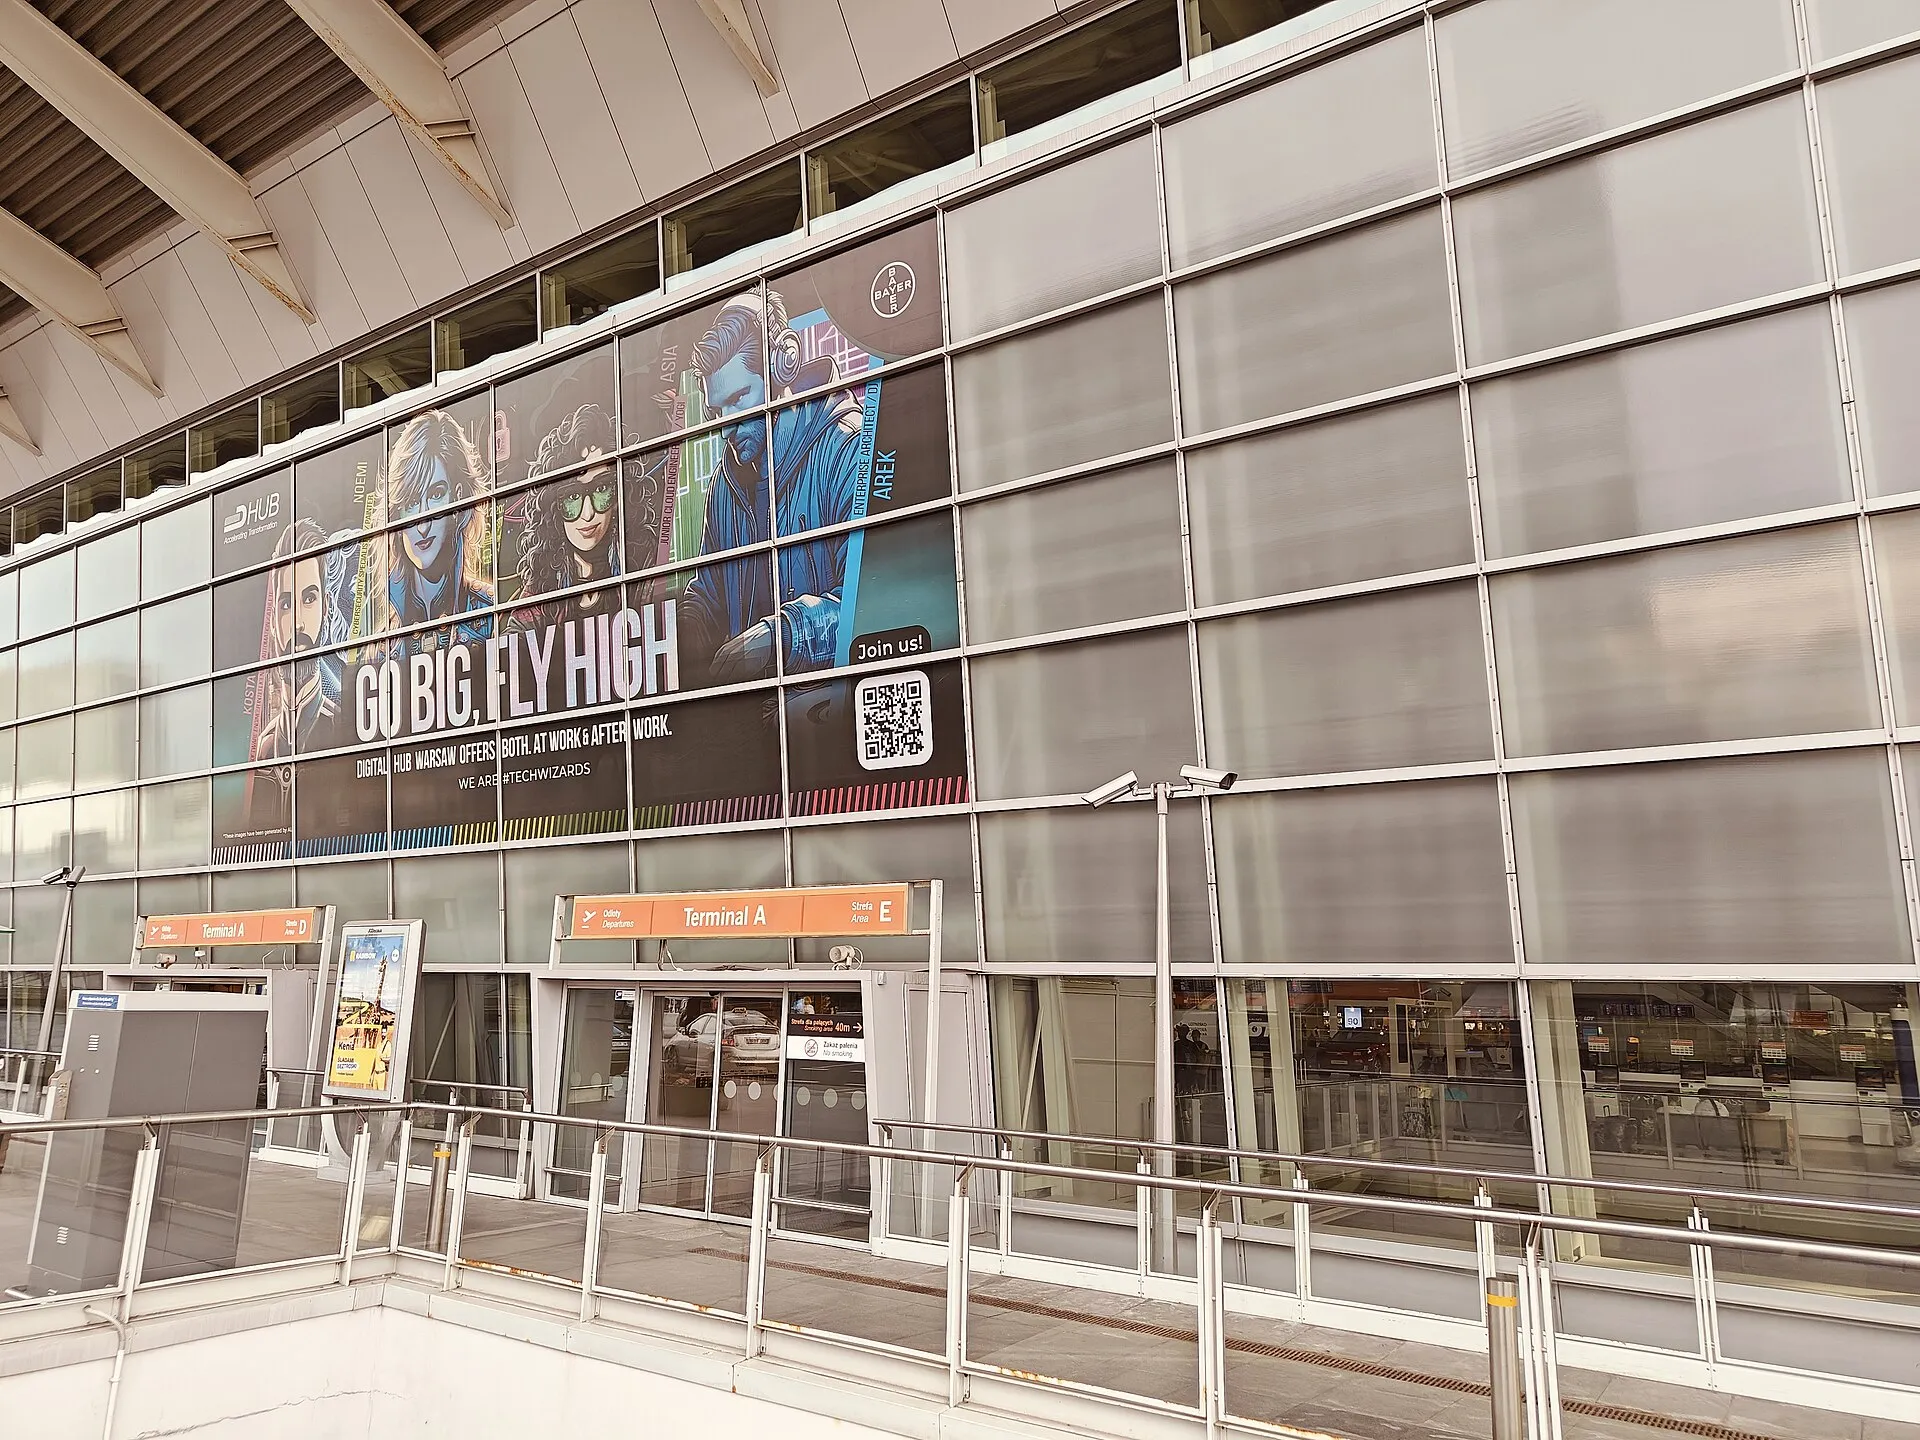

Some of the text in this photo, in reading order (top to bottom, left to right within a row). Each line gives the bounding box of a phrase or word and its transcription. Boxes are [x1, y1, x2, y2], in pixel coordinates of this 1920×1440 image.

[875, 280, 912, 300] BAYER
[888, 267, 898, 313] BAYER
[660, 345, 678, 382] ASIA
[868, 383, 878, 394] DJ
[676, 402, 686, 420] YOGI
[860, 406, 876, 456] ARCHITECT
[668, 444, 680, 485] ENGINEER
[873, 449, 897, 500] AREK
[353, 461, 368, 503] NOEMI
[854, 459, 870, 515] ENTERPRISE
[664, 487, 675, 513] CLOUD
[661, 516, 672, 545] JUNIOR
[353, 579, 364, 635] CYBERSECURITY
[365, 495, 374, 525] PAINTER
[857, 634, 923, 660] Join us!
[355, 599, 680, 742] GO BIG, FLY HIGH
[243, 675, 256, 715] KOSTA
[356, 714, 673, 779] DIGITAL HUB WARSAW OFFERS BOTH. AT WORK & AFTER WORK.
[458, 762, 591, 790] WE ARE #TECHWIZARDS
[602, 920, 634, 929] Departures
[603, 909, 621, 919] Odloty
[683, 904, 767, 927] Terminal A
[850, 914, 869, 923] Area
[851, 900, 892, 922] Strefa E
[202, 922, 245, 938] Terminal A
[298, 919, 307, 935] D
[835, 1022, 850, 1033] 40m
